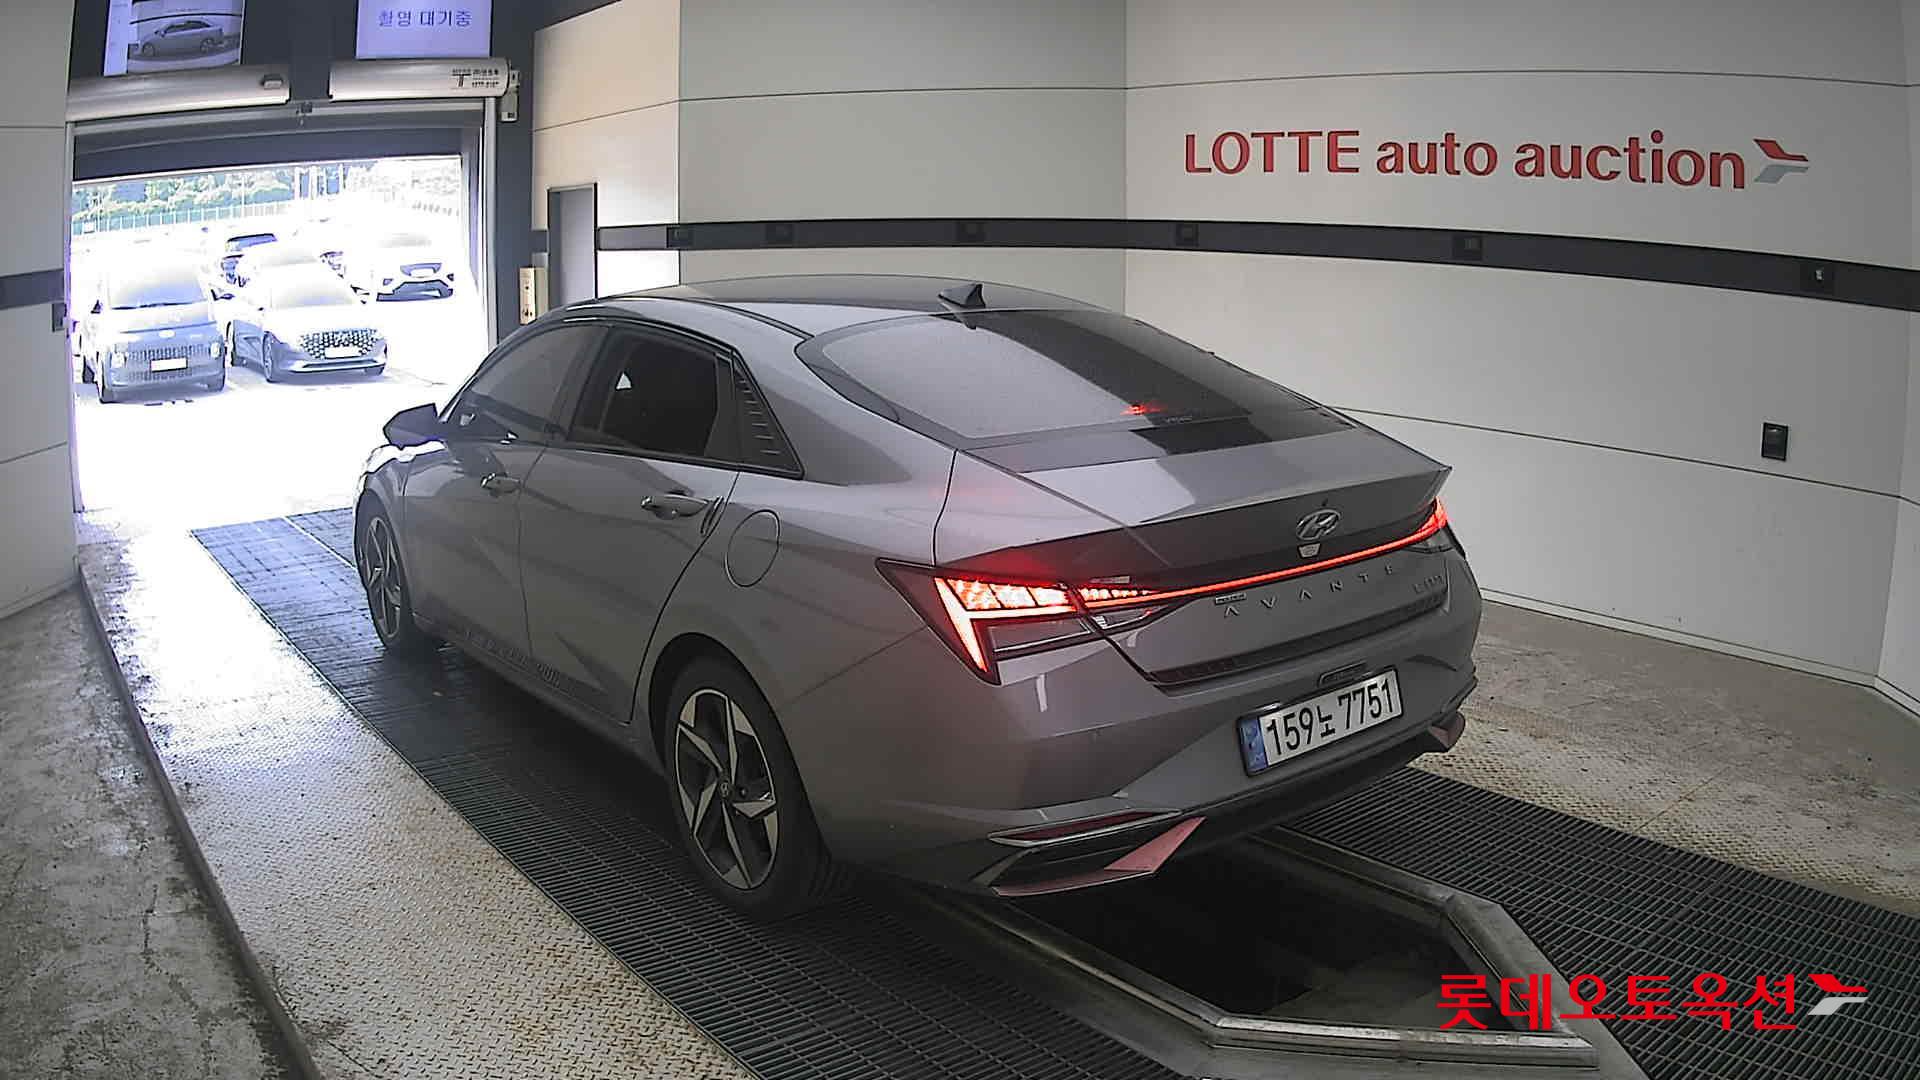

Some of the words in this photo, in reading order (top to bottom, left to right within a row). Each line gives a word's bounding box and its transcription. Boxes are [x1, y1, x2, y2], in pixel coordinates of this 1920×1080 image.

[420, 10, 472, 27] 대기중
[1185, 130, 1360, 175] LOTTE
[1377, 132, 1499, 177] auto
[1514, 129, 1746, 189] auction
[1223, 563, 1394, 618] AVANTE
